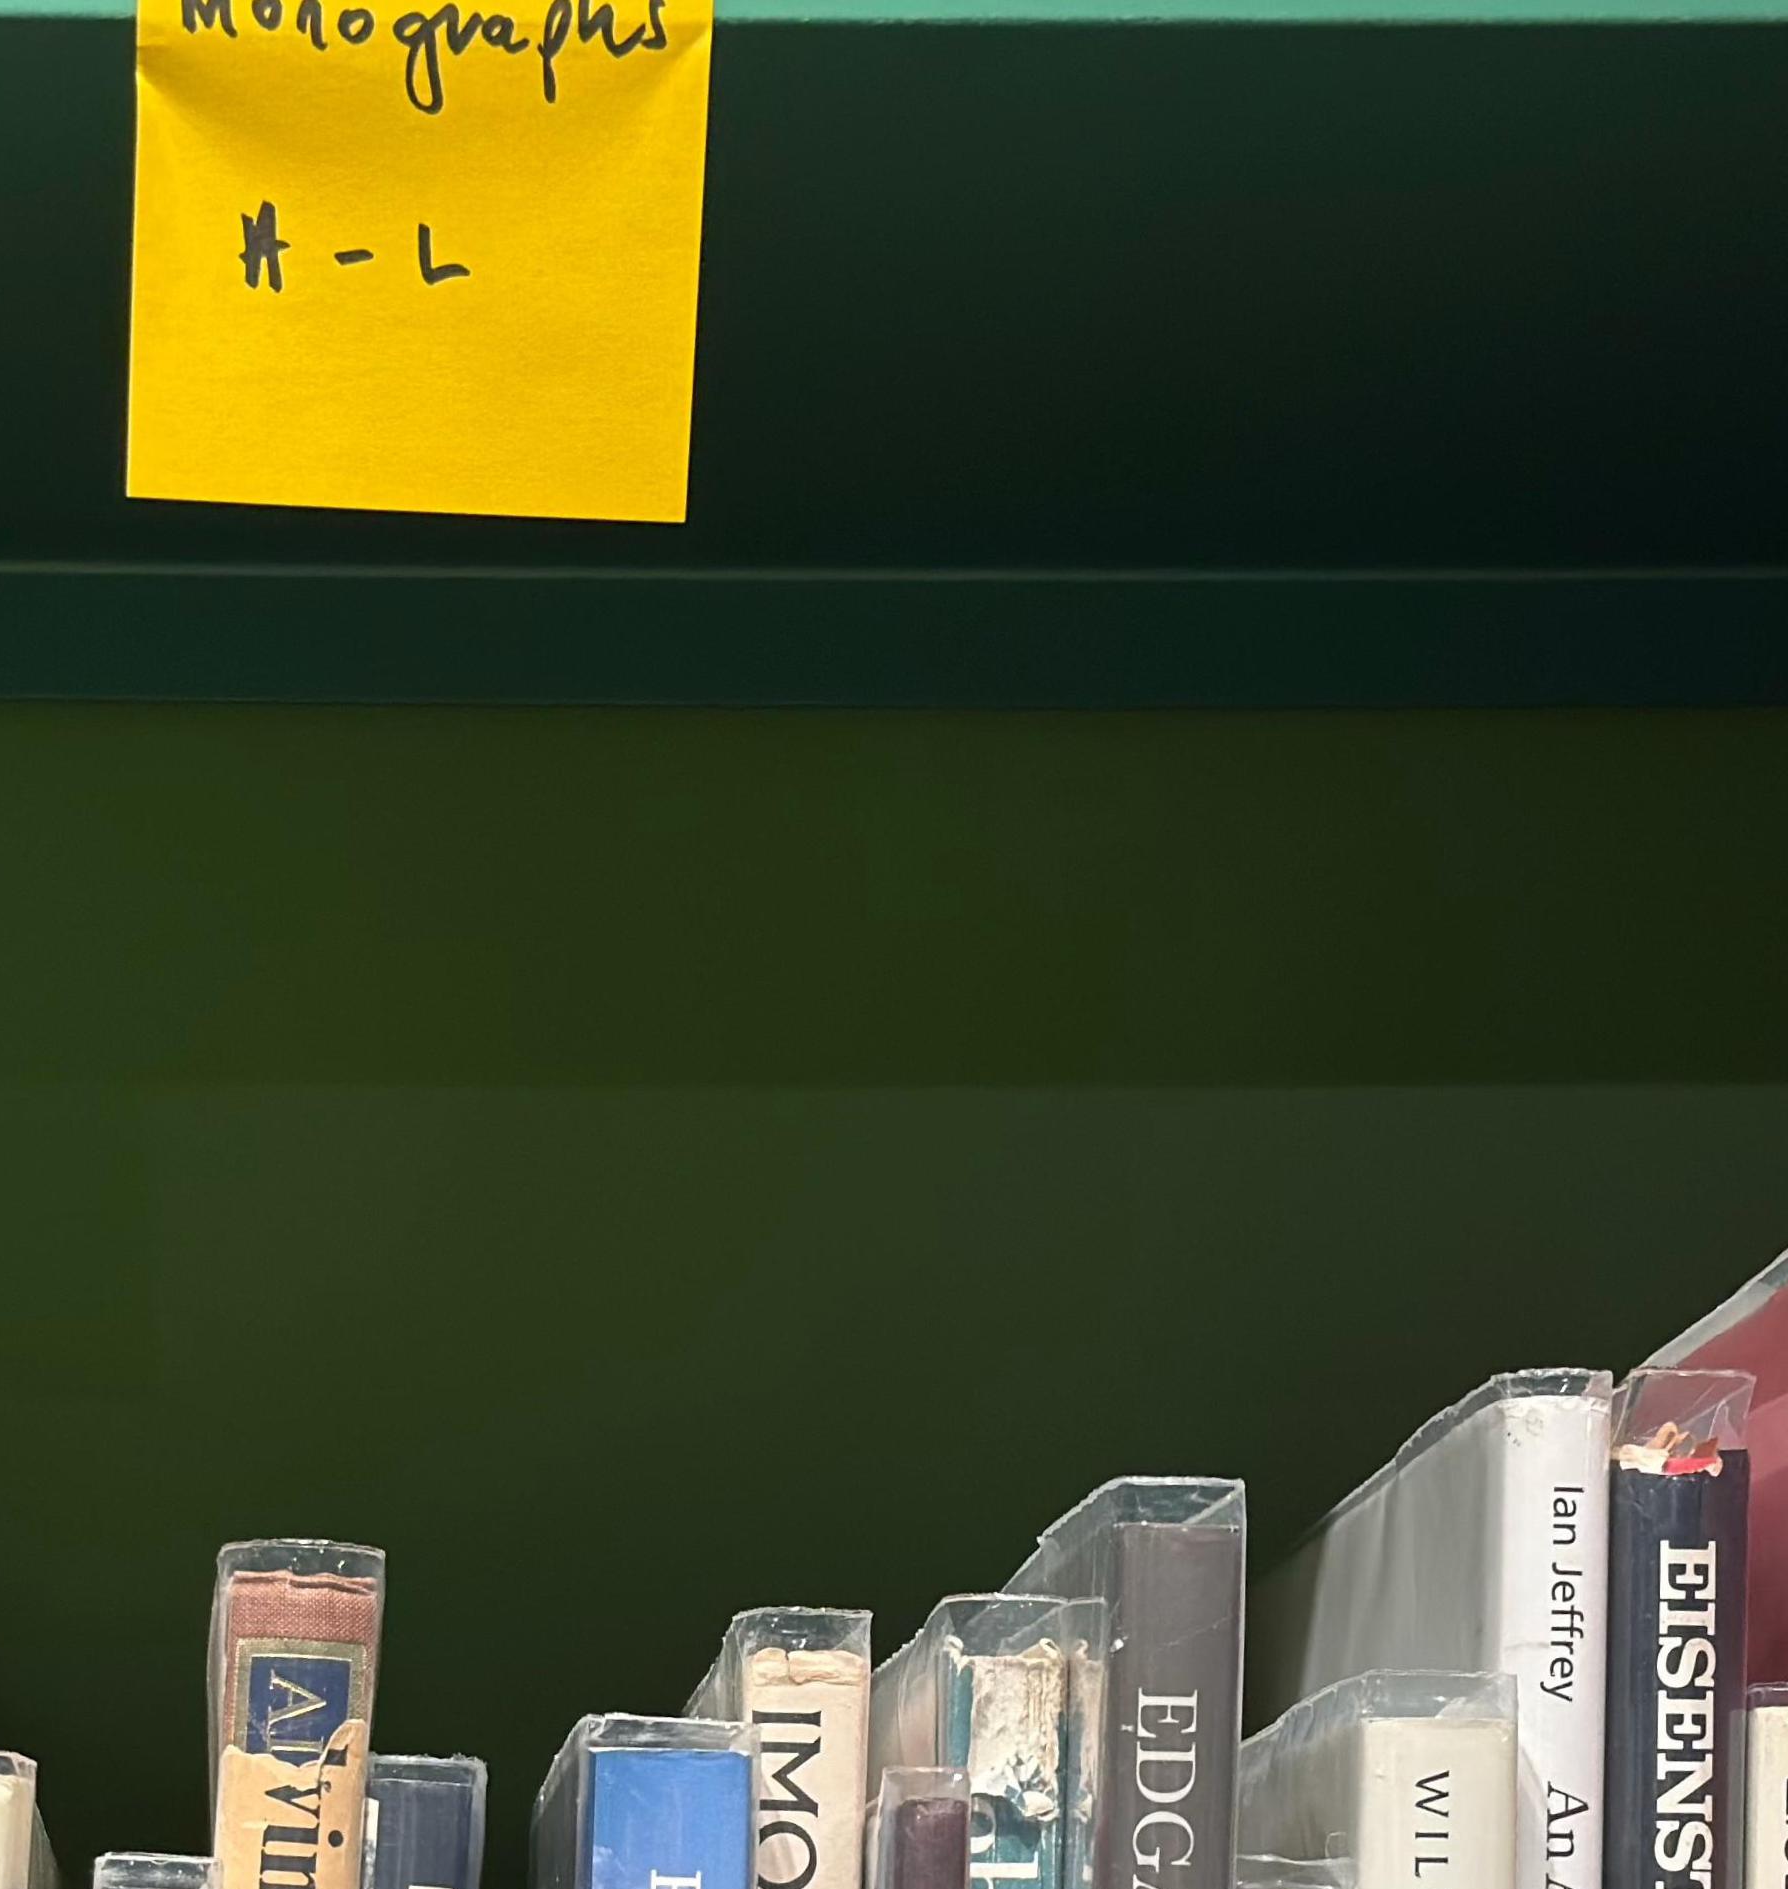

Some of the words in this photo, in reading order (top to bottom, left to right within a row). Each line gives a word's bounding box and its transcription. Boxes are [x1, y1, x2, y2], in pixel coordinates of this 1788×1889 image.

[418, 222, 472, 285] L
[1550, 1484, 1585, 1546] Ian
[1539, 1562, 1584, 1703] Jeffrey
[1545, 1782, 1589, 1861] An
